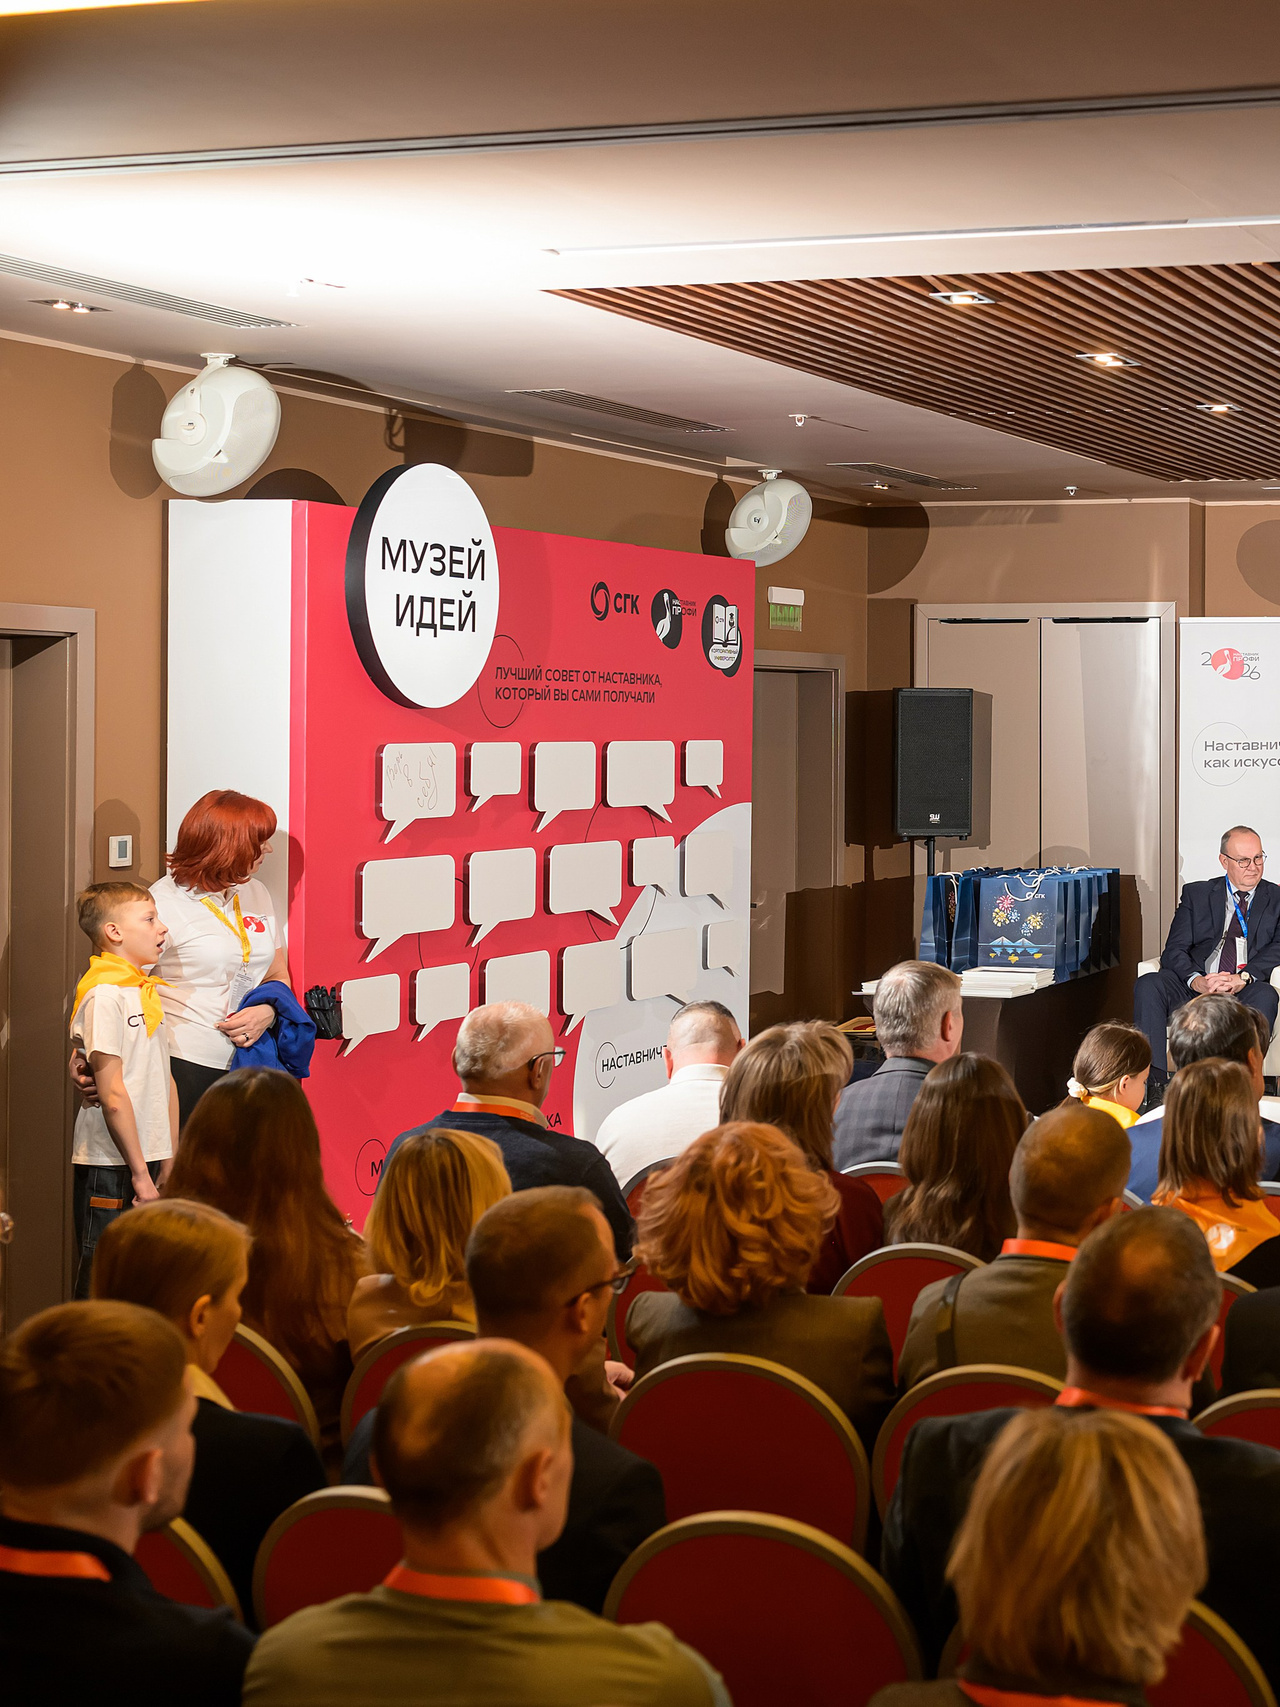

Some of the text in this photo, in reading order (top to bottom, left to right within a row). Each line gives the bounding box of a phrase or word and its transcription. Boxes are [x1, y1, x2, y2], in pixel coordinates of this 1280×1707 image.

[381, 536, 486, 582] МУЗЕЙ
[395, 589, 477, 638] ИДЕЙ
[613, 592, 641, 615] СГК
[671, 605, 697, 617] ПРОФИ
[495, 664, 663, 688] ЛУЧШИЙ СОВЕТ ОТ НАСТАВНИКА,
[495, 685, 656, 703] КОТОРЫЙ ВЫ САМИ ПОЛУЧАЛИ
[1203, 758, 1231, 768] как
